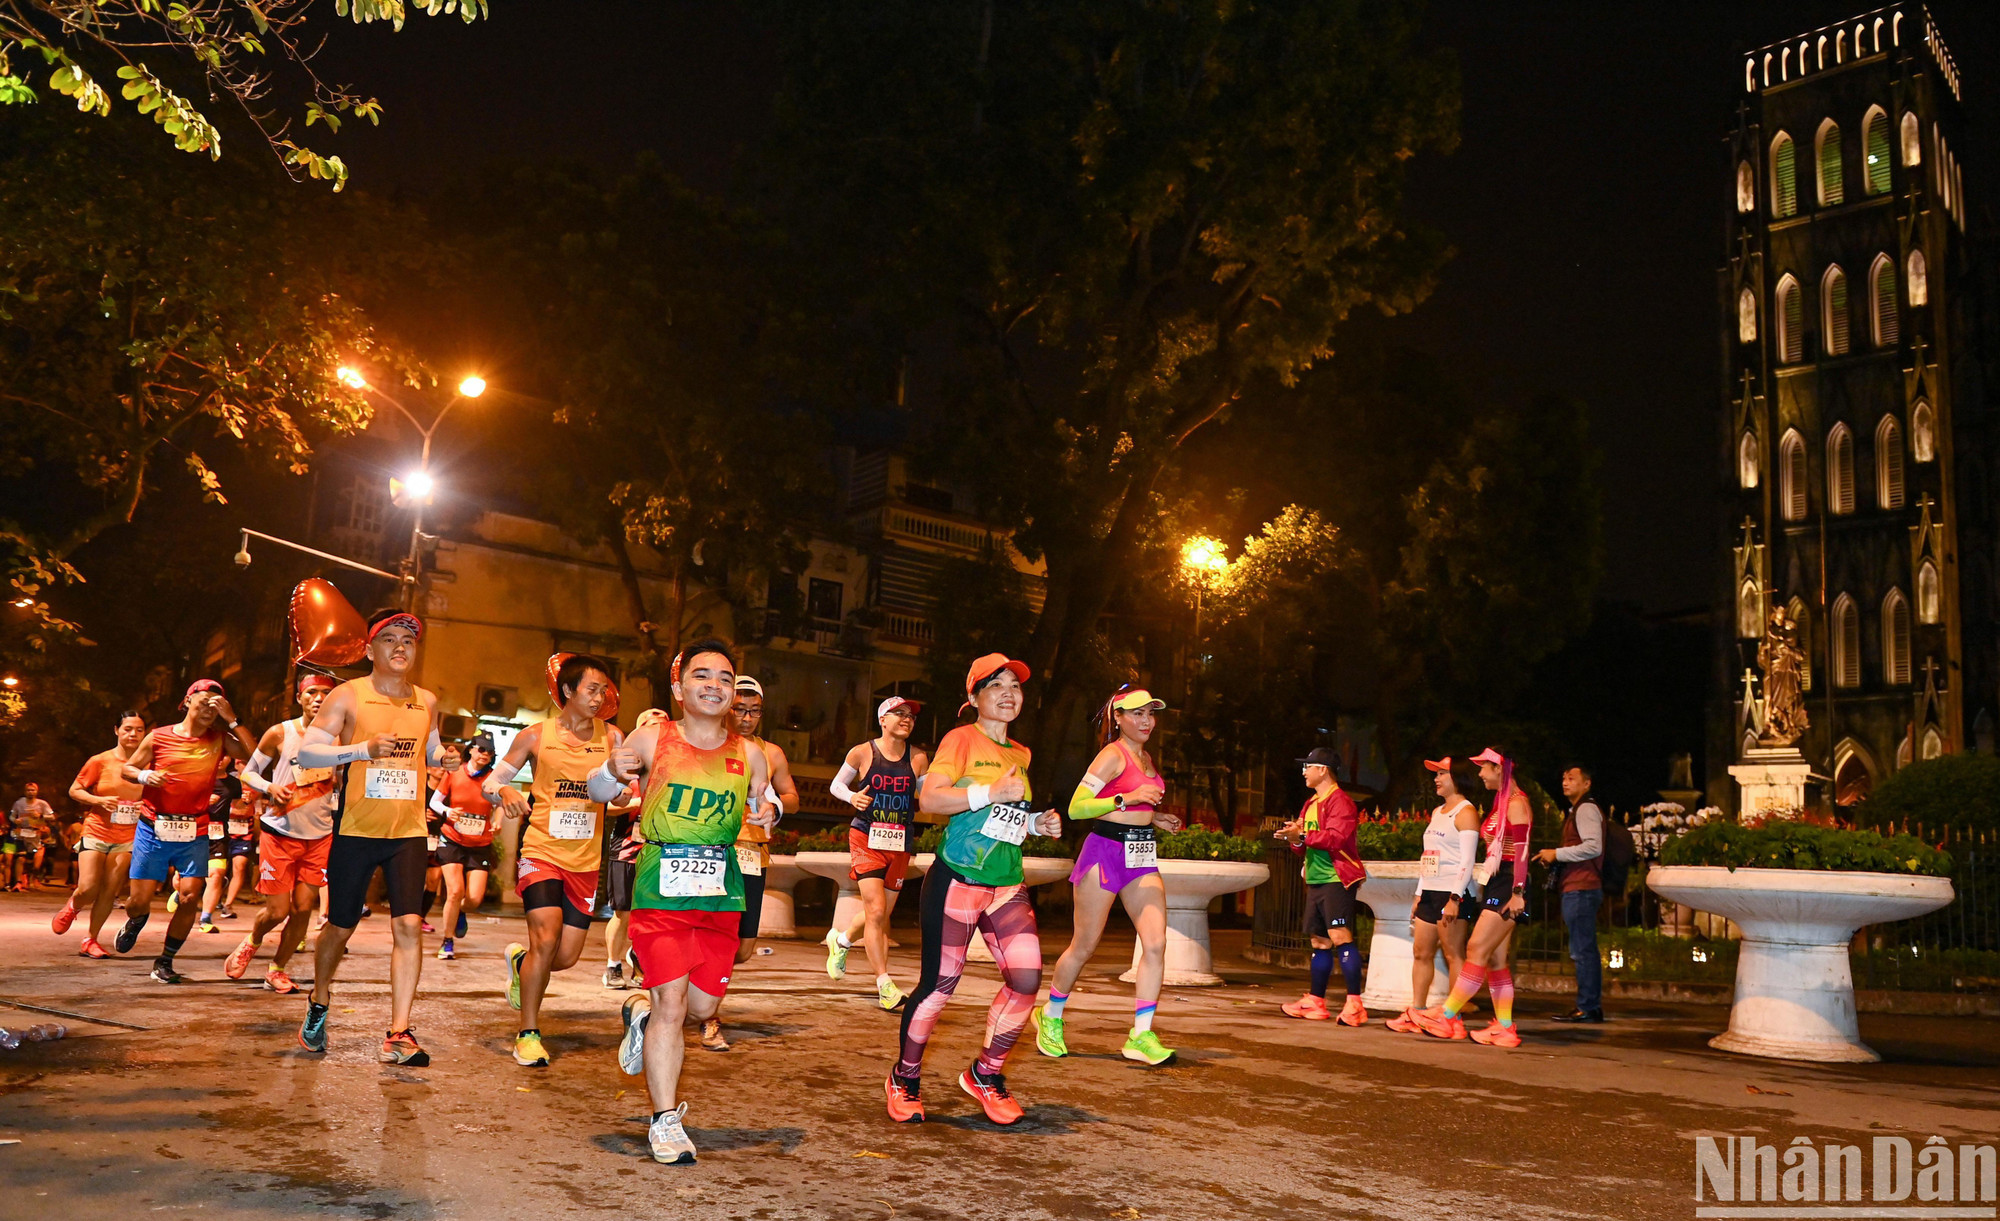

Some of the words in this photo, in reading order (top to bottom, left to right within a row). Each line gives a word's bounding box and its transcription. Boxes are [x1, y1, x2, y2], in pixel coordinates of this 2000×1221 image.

[394, 741, 416, 751] NOI
[379, 769, 407, 778] PACER
[391, 777, 409, 785] 4:30
[555, 791, 590, 800] MIDNIGH
[872, 793, 911, 811] ATION
[562, 812, 588, 820] PACER
[872, 809, 909, 823] SMILE
[992, 804, 1026, 828] 92969
[162, 821, 190, 830] 91149
[872, 829, 904, 840] 142049
[1128, 842, 1155, 854] 95853
[670, 859, 718, 875] 92225
